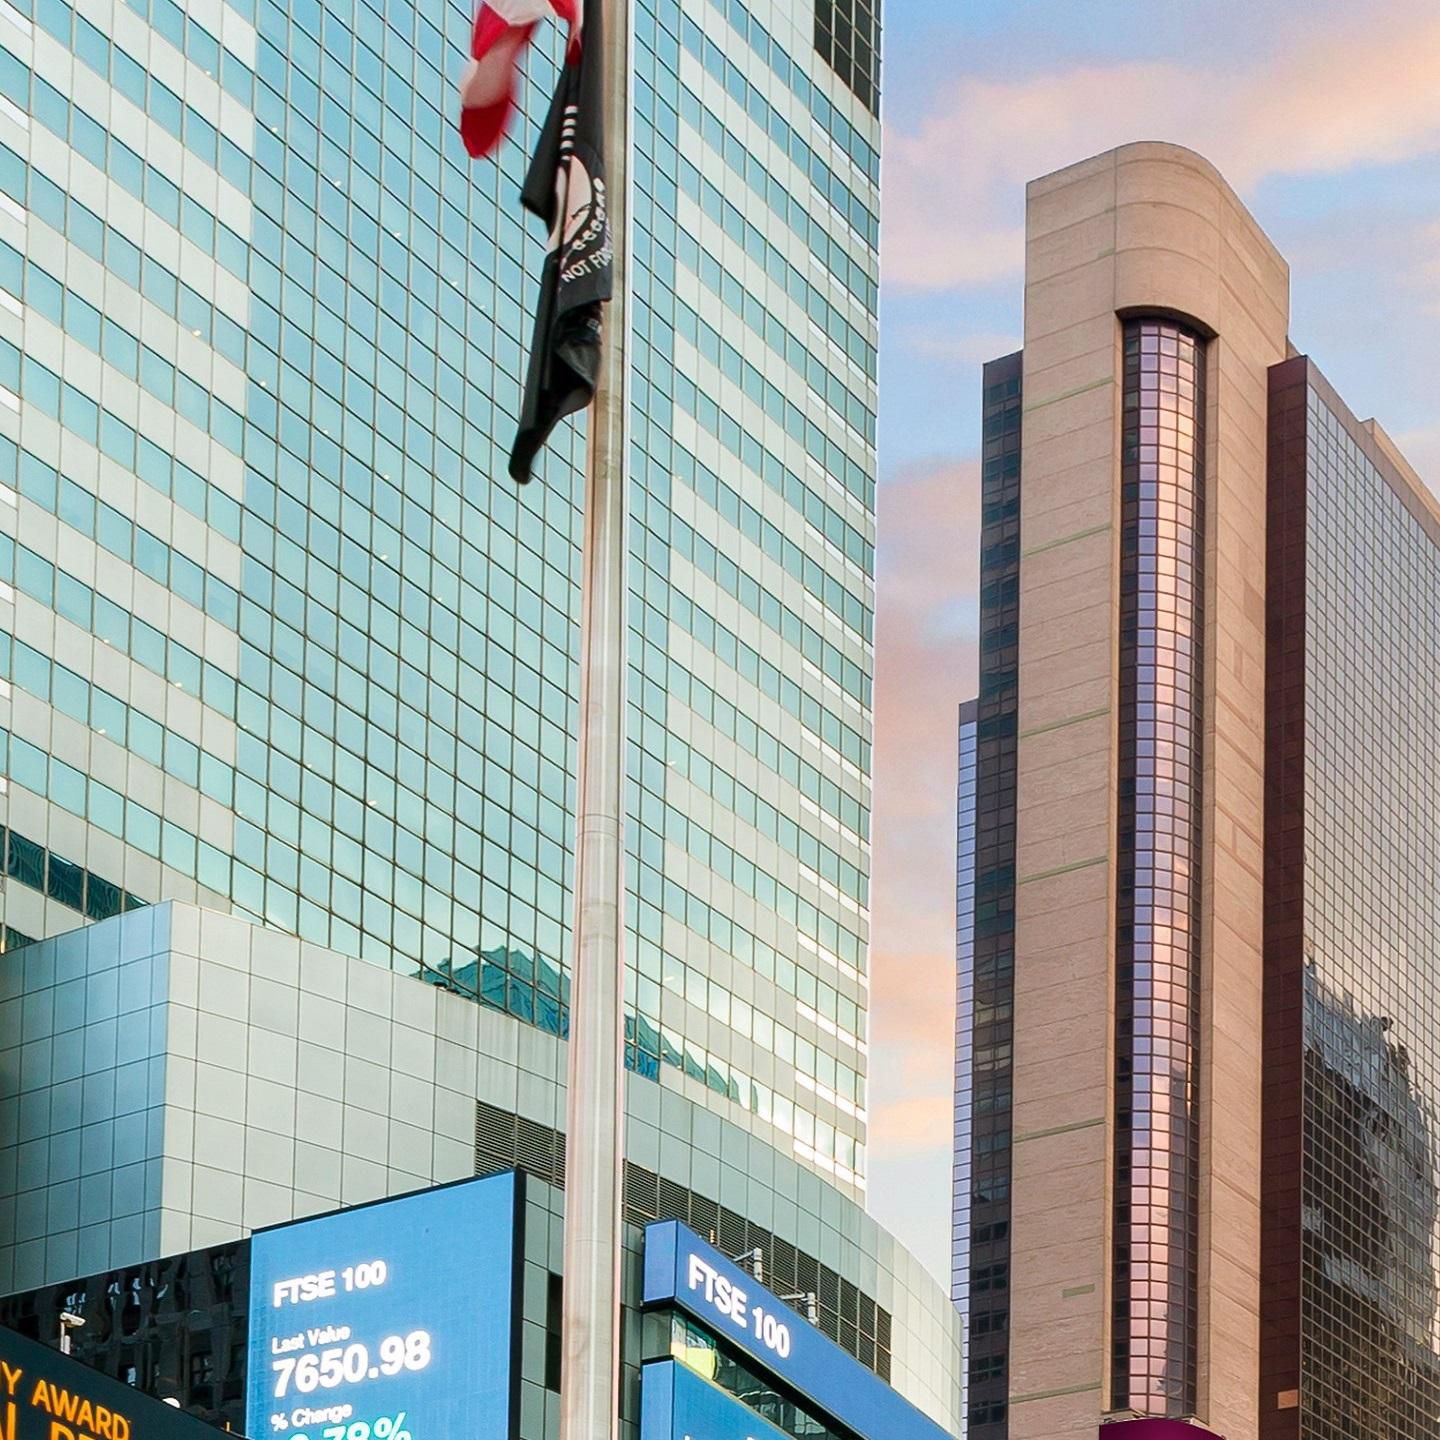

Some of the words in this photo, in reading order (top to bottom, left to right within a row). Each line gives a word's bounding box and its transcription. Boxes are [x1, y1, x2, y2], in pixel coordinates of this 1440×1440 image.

[561, 258, 592, 283] NOT
[273, 1270, 336, 1308] FTSE
[342, 1260, 387, 1291] 100
[687, 1253, 748, 1329] FTSE
[752, 1306, 791, 1359] 100
[272, 1333, 304, 1354] Last
[307, 1325, 351, 1346] Value
[272, 1330, 431, 1398] 7650.98
[271, 1413, 288, 1431] %
[291, 1404, 352, 1428] Change
